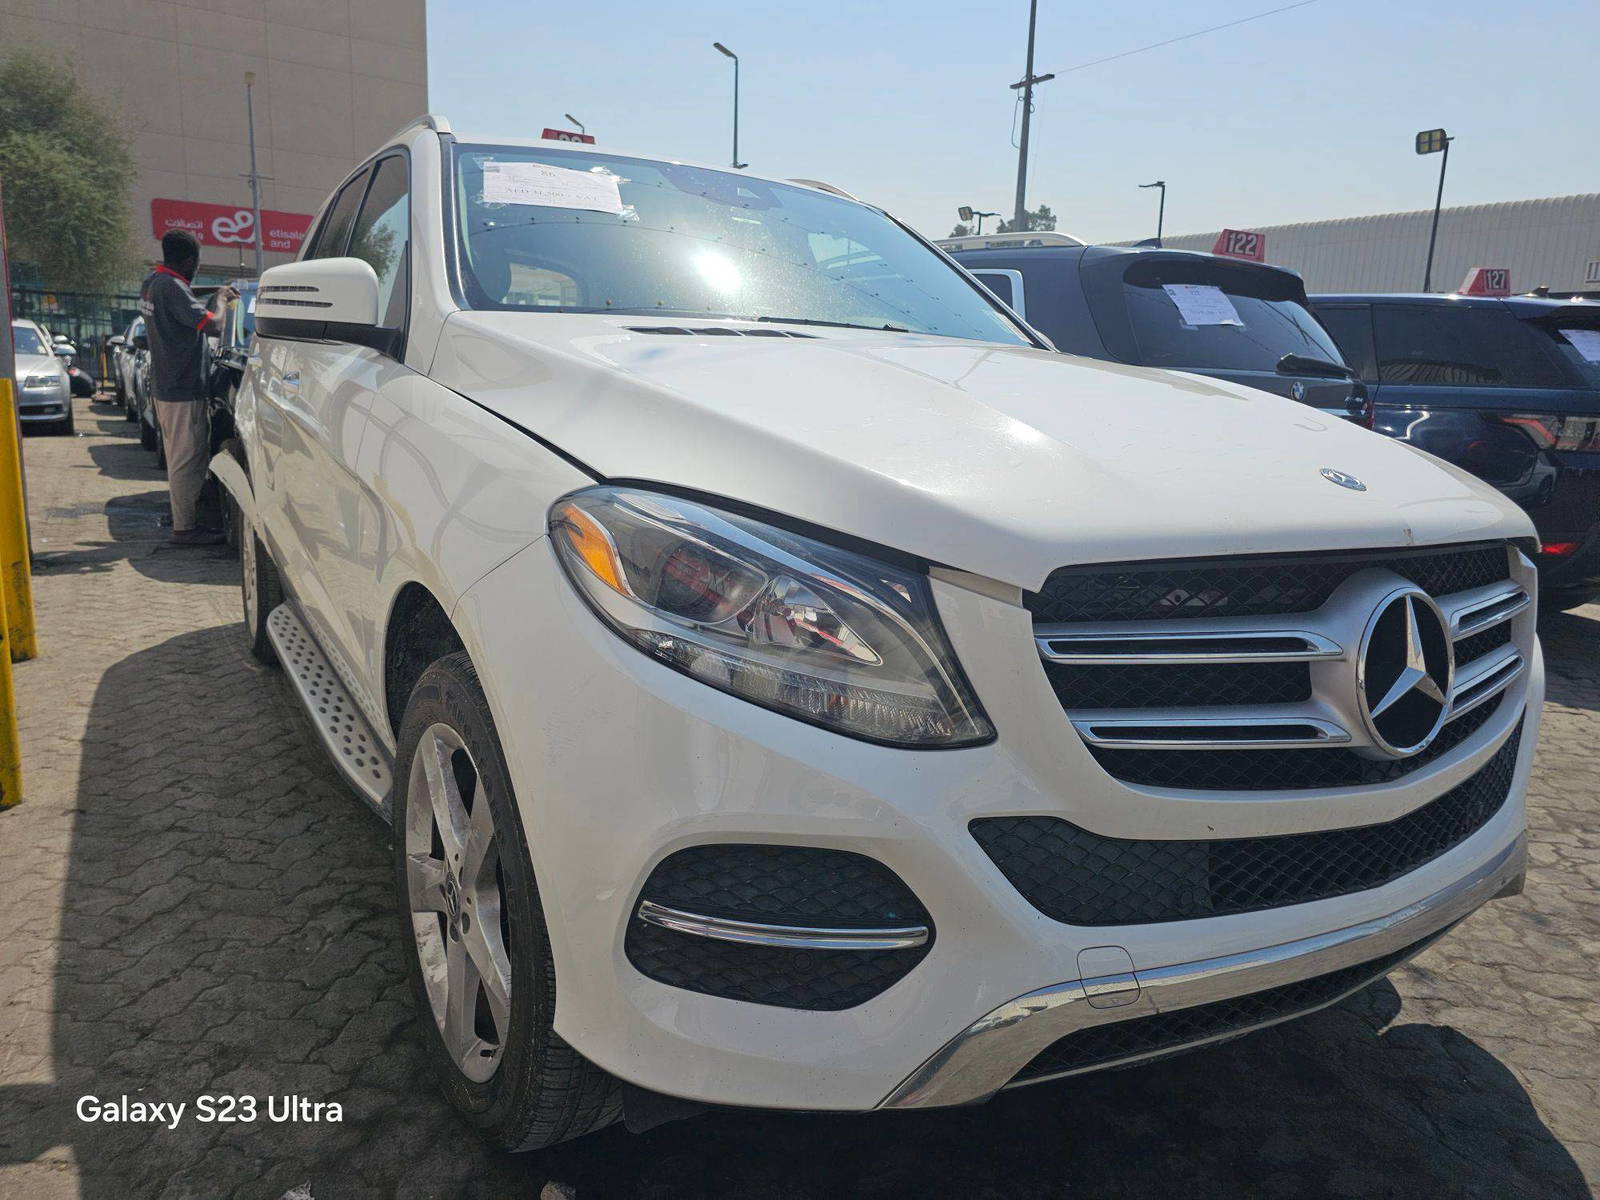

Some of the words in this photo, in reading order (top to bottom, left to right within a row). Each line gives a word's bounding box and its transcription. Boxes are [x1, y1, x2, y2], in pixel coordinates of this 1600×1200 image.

[269, 228, 305, 241] etisala
[270, 239, 291, 249] and
[1228, 231, 1257, 255] 122
[1487, 271, 1506, 289] 127
